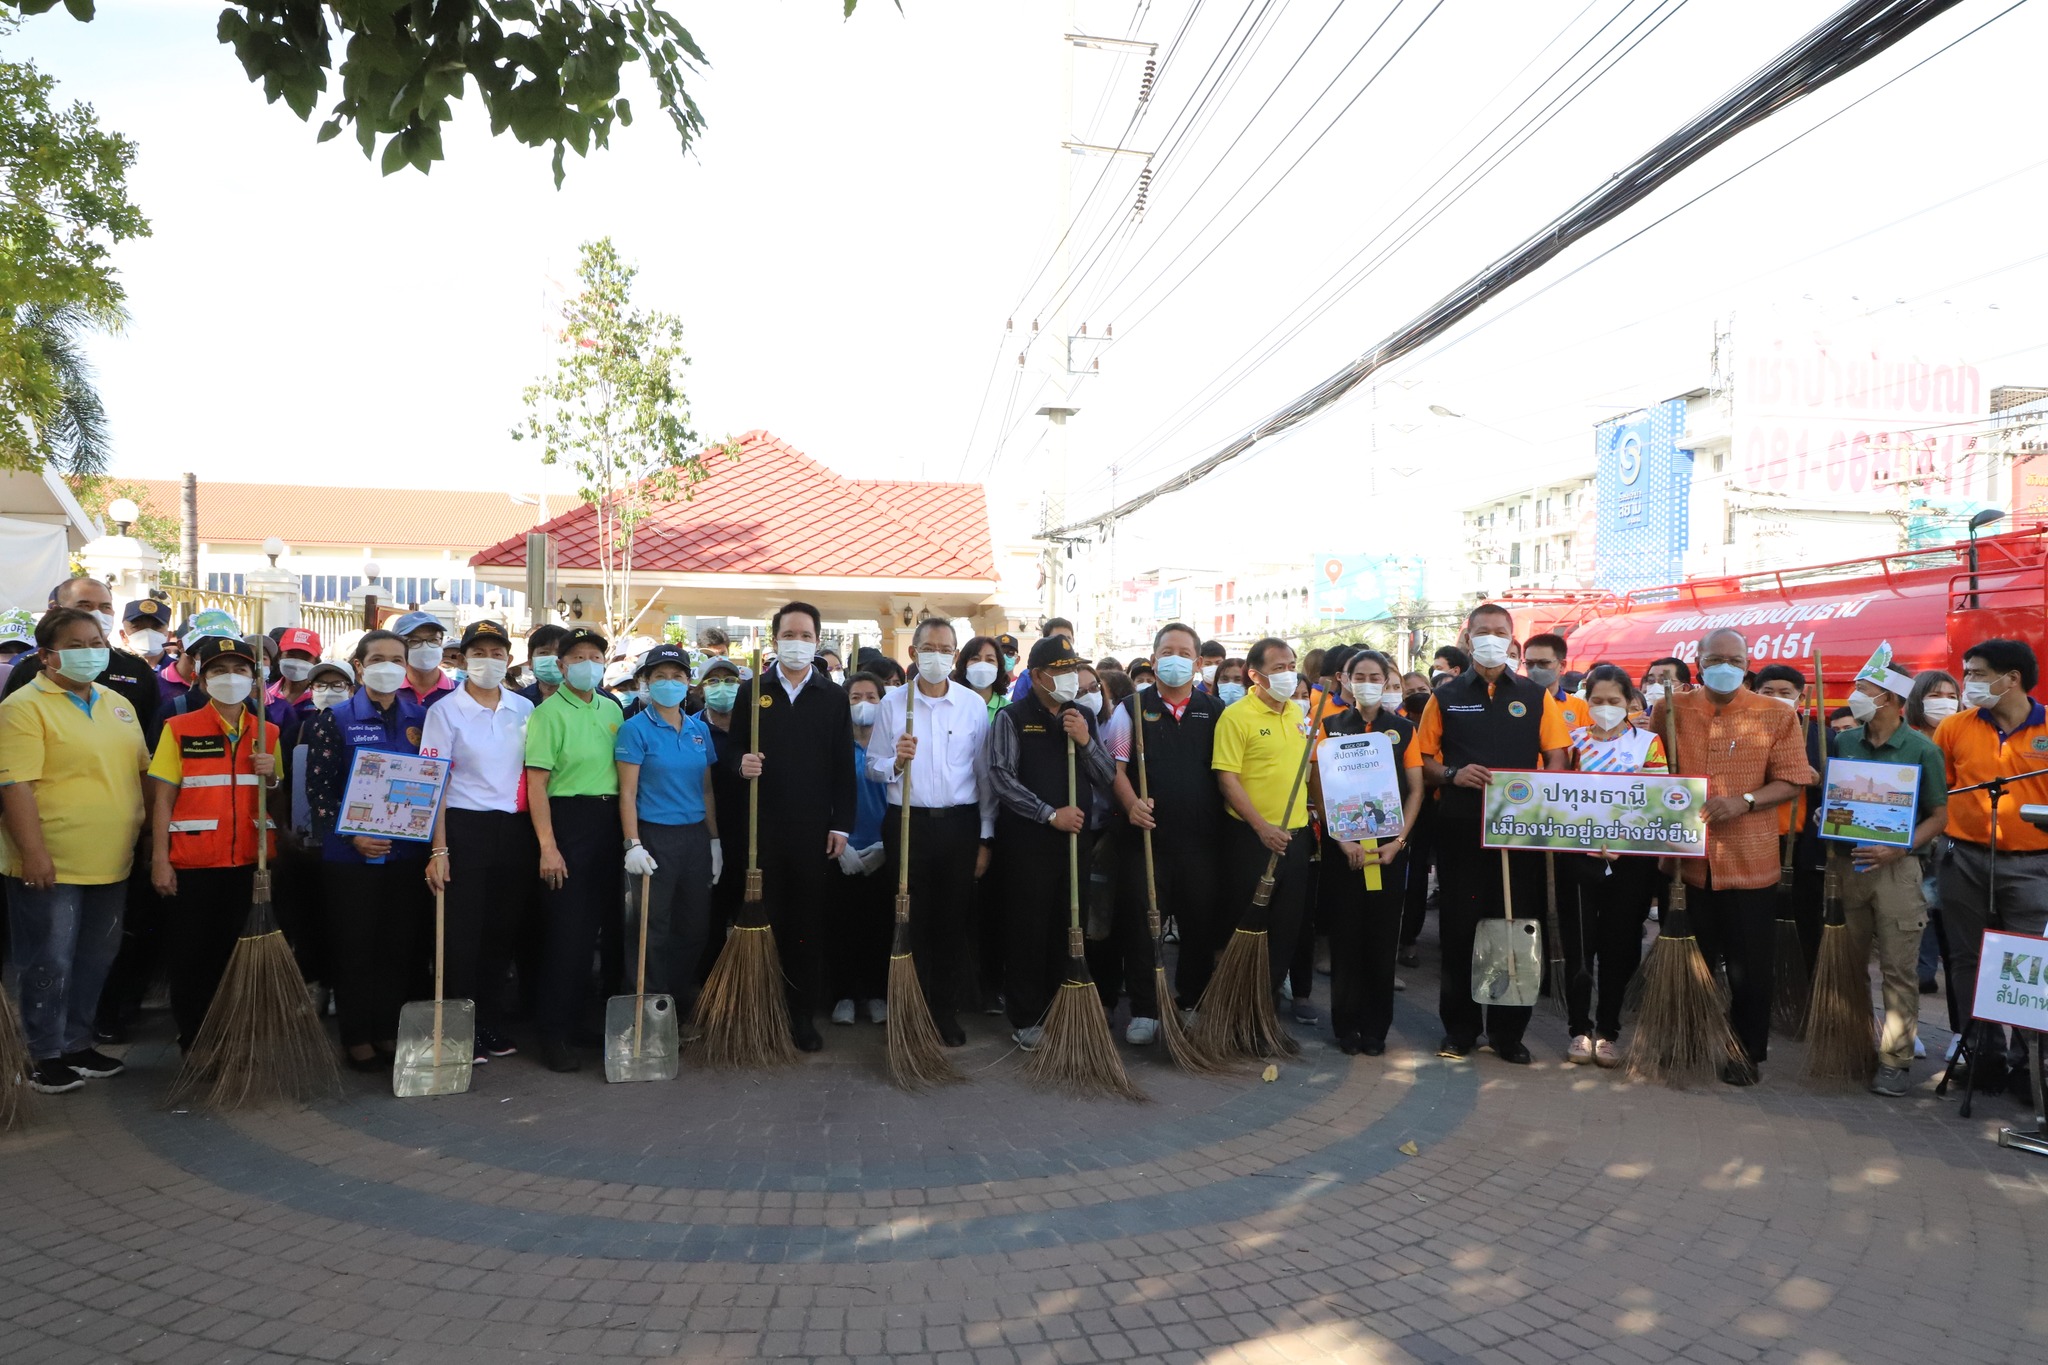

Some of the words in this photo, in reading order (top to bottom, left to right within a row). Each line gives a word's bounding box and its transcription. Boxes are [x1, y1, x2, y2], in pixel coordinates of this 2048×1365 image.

[1655, 595, 1881, 634] เทศบาลเมืองปทุมธานี
[1543, 782, 1648, 812] ปทุมธานี
[1491, 814, 1698, 846] เมืองน่าอยู่อย่างยั่งยืน
